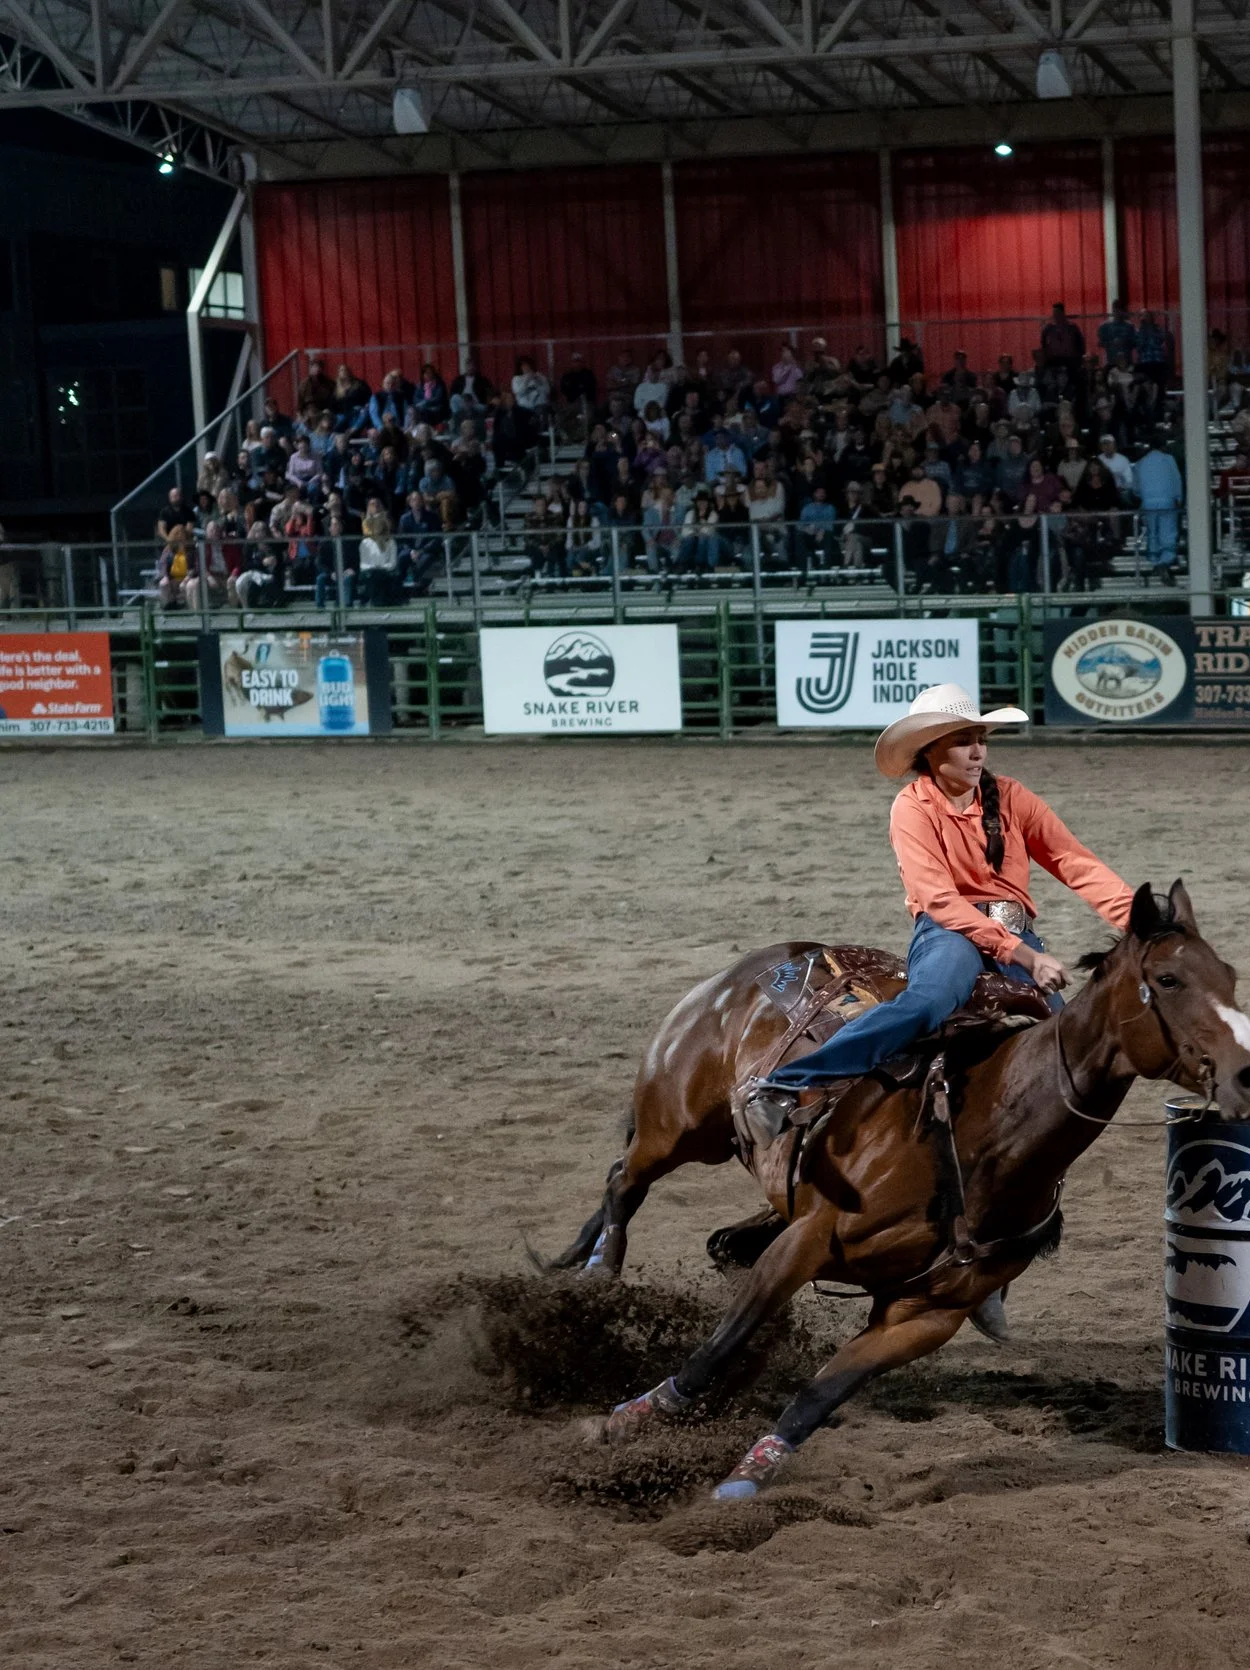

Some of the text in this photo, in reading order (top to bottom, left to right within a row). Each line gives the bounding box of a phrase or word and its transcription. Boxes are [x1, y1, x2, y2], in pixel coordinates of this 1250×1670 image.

[871, 638, 960, 659] JACKSON
[1063, 624, 1173, 659] HIDDEN BASIN
[32, 650, 52, 662] the
[54, 649, 82, 662] deal.
[15, 664, 24, 676] is
[26, 664, 63, 676] better
[65, 664, 91, 676] with
[241, 669, 299, 688] EASY TO
[872, 661, 918, 682] HOLE
[249, 688, 294, 706] DRINK
[322, 682, 350, 694] BUD
[872, 683, 942, 703] INDO
[523, 700, 640, 716] SNAKE RIVER
[1075, 691, 1165, 717] OUTFITTERS
[30, 720, 111, 733] 307-733-4215
[552, 717, 613, 728] BREWING
